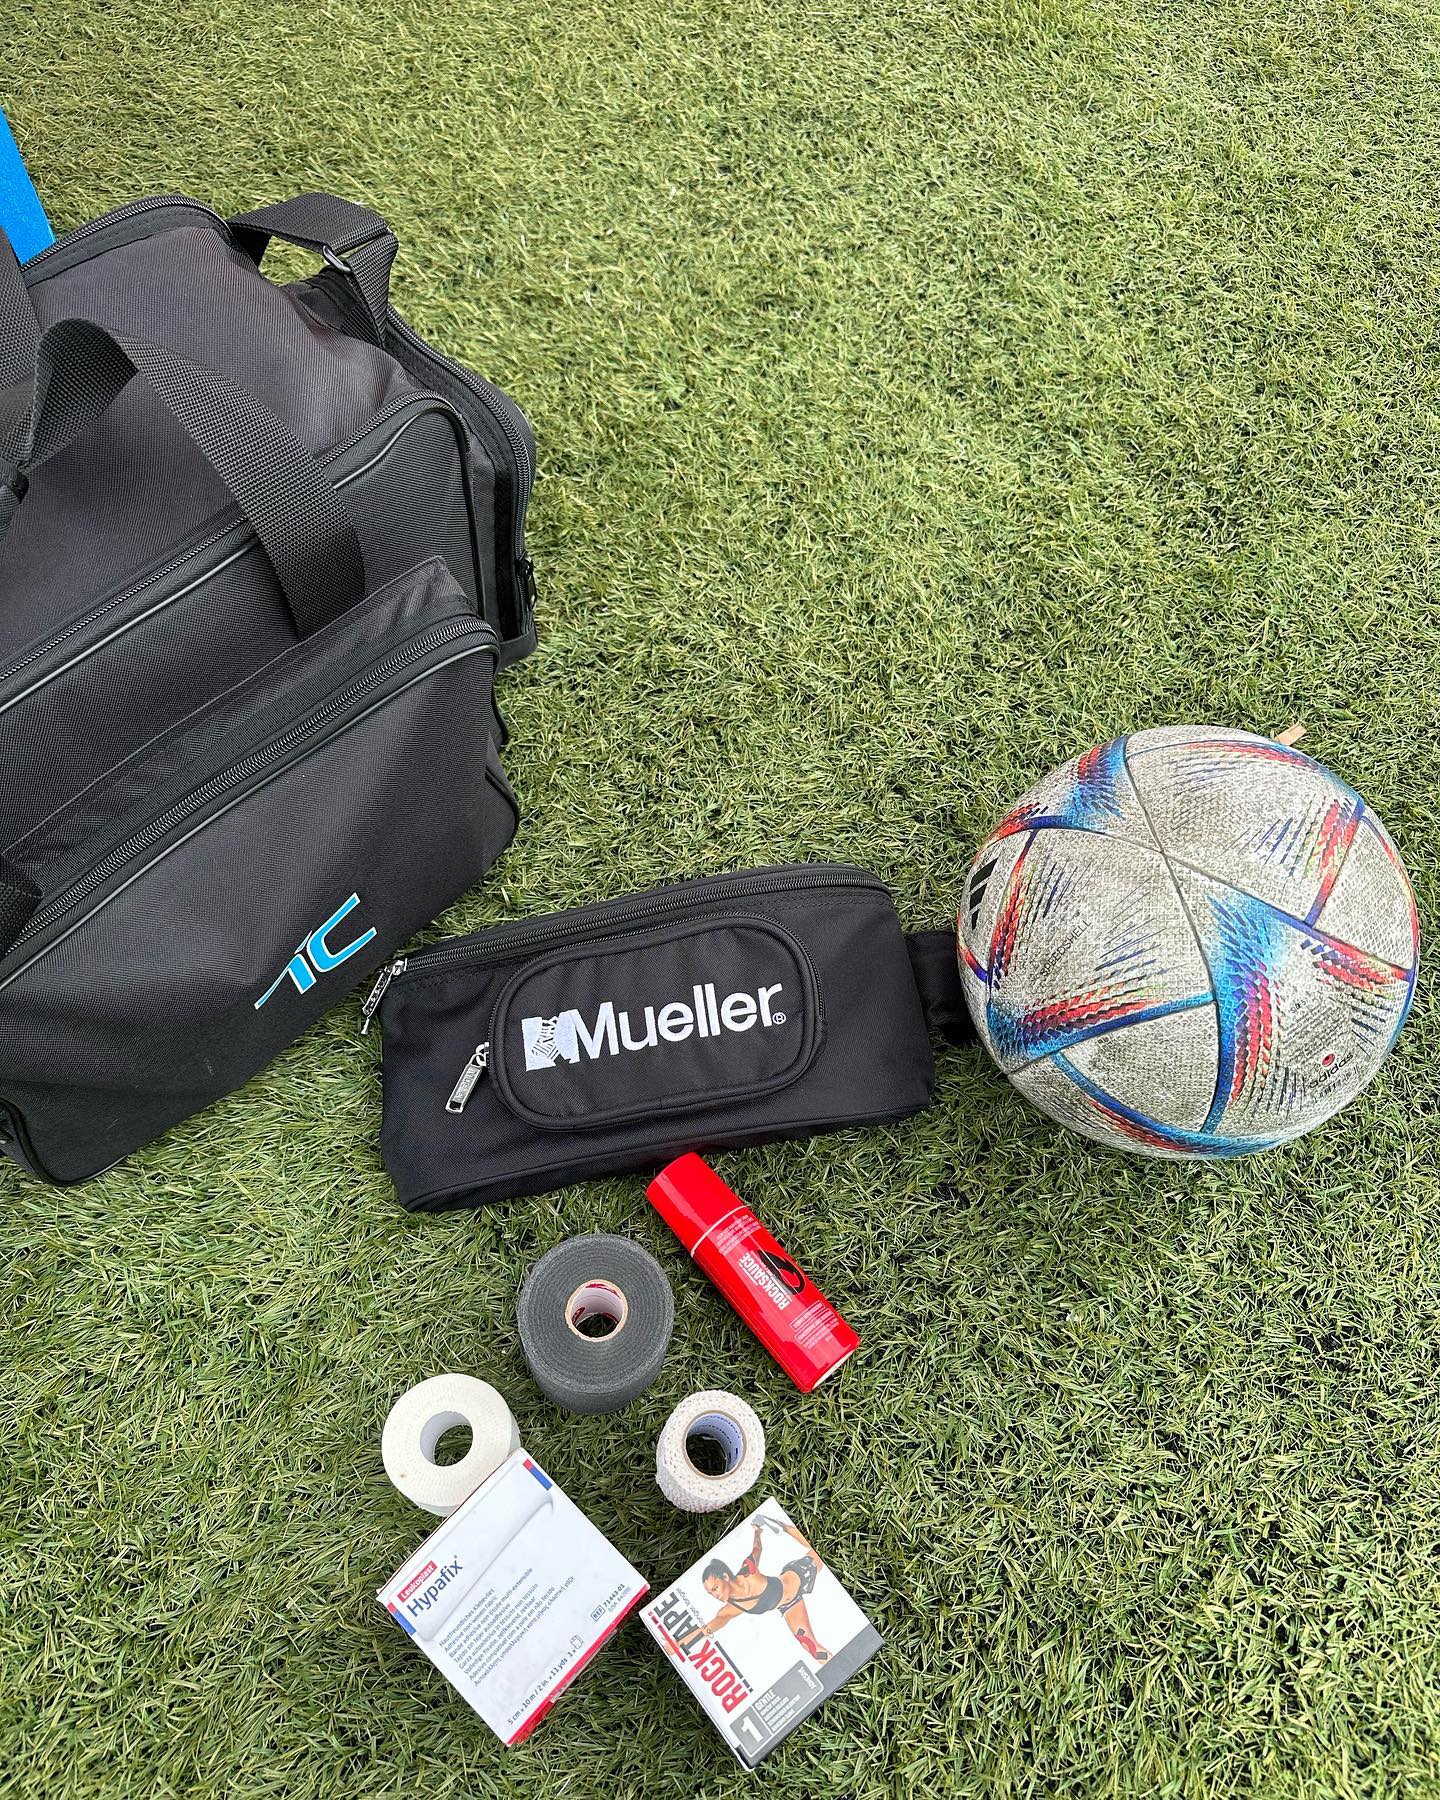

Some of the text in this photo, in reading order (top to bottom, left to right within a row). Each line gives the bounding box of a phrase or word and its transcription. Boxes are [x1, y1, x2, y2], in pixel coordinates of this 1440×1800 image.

[1040, 920, 1092, 977] SPEEDSHELL
[1309, 1052, 1353, 1088] adidas
[739, 1252, 793, 1311] ROCKSAUCE
[399, 1562, 435, 1600] Leukoplast
[405, 1556, 465, 1620] Hypafix
[592, 1607, 603, 1619] REF
[511, 1709, 520, 1720] cm
[521, 1697, 531, 1708] 10
[550, 1666, 559, 1676] 11
[556, 1656, 568, 1670] yds
[737, 1715, 764, 1746] 1
[754, 1688, 776, 1711] GENTLE
